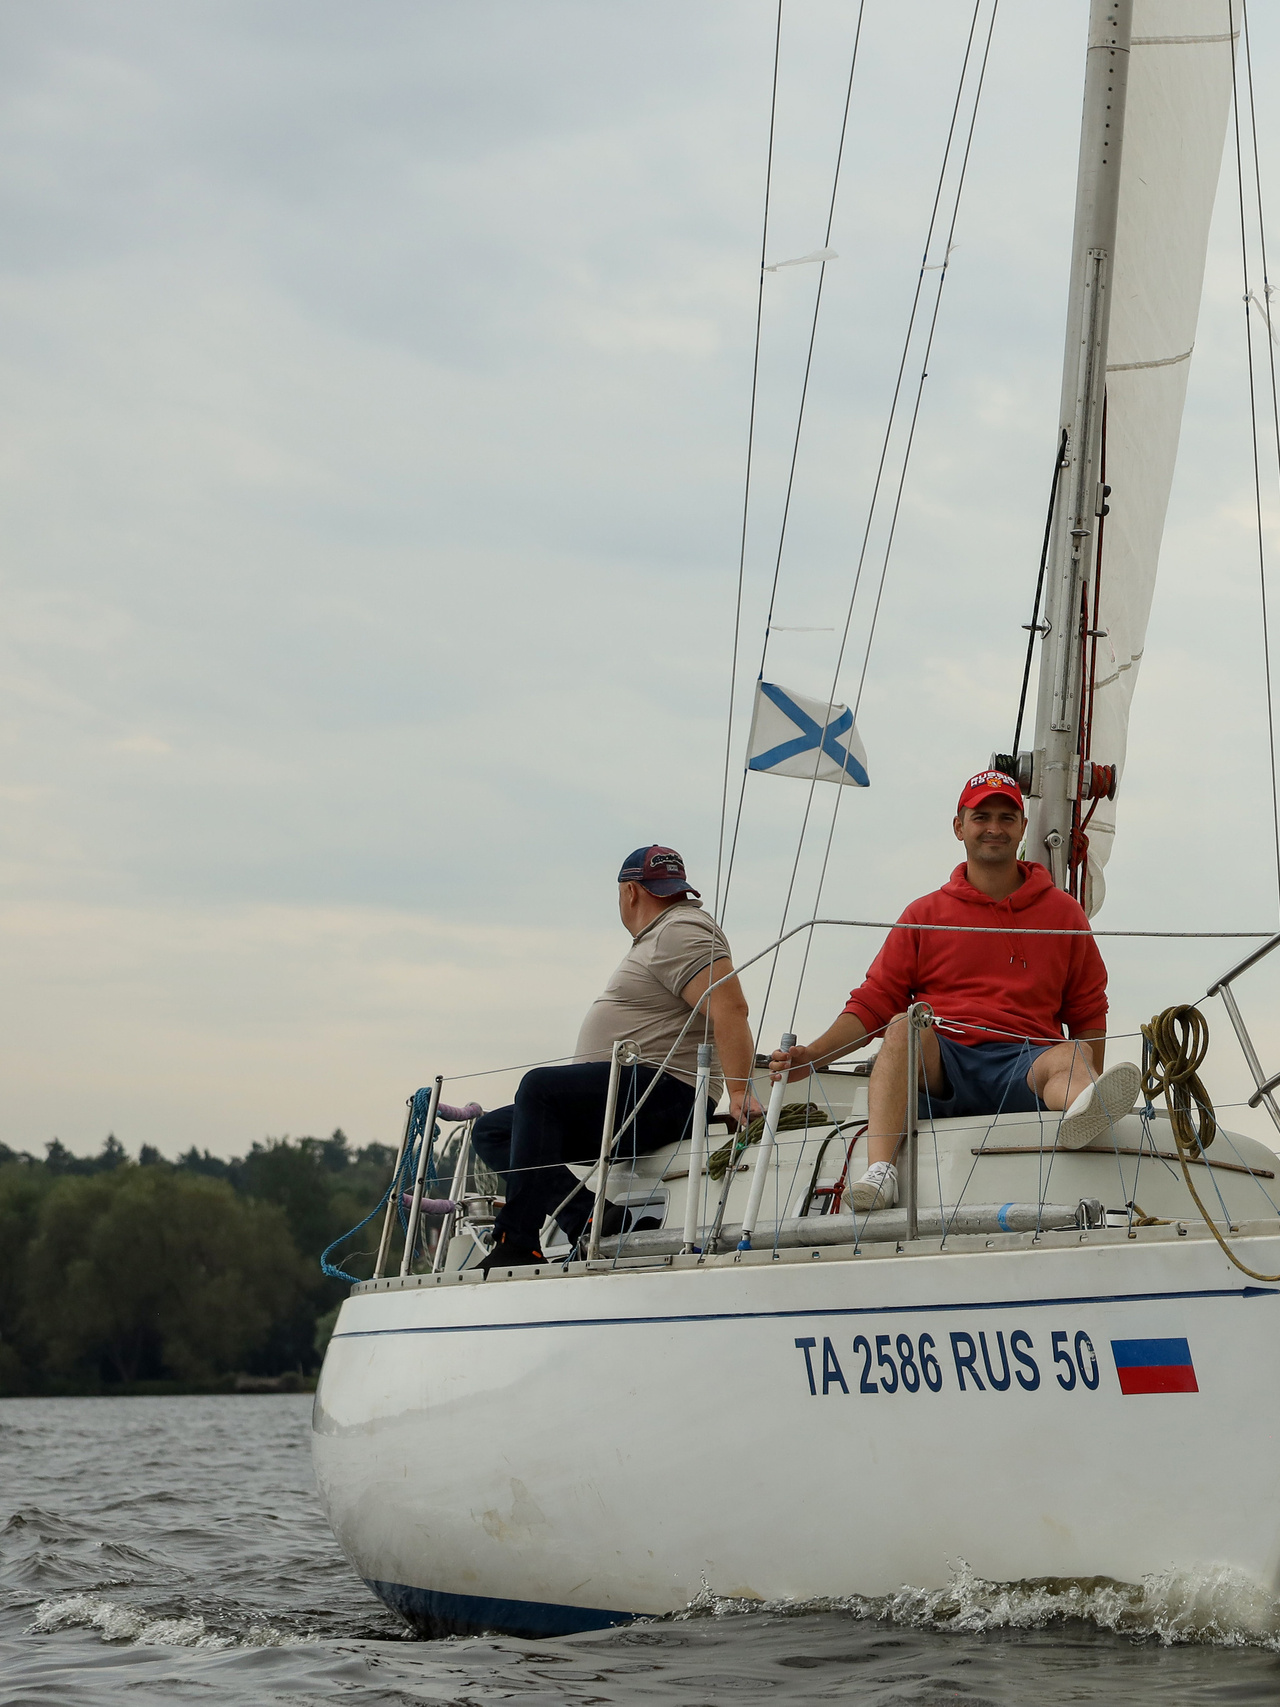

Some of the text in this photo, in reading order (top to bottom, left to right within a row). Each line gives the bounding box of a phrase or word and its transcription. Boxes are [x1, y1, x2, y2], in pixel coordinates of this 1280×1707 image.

[794, 1330, 1101, 1396] TA 2586 RUS 50
